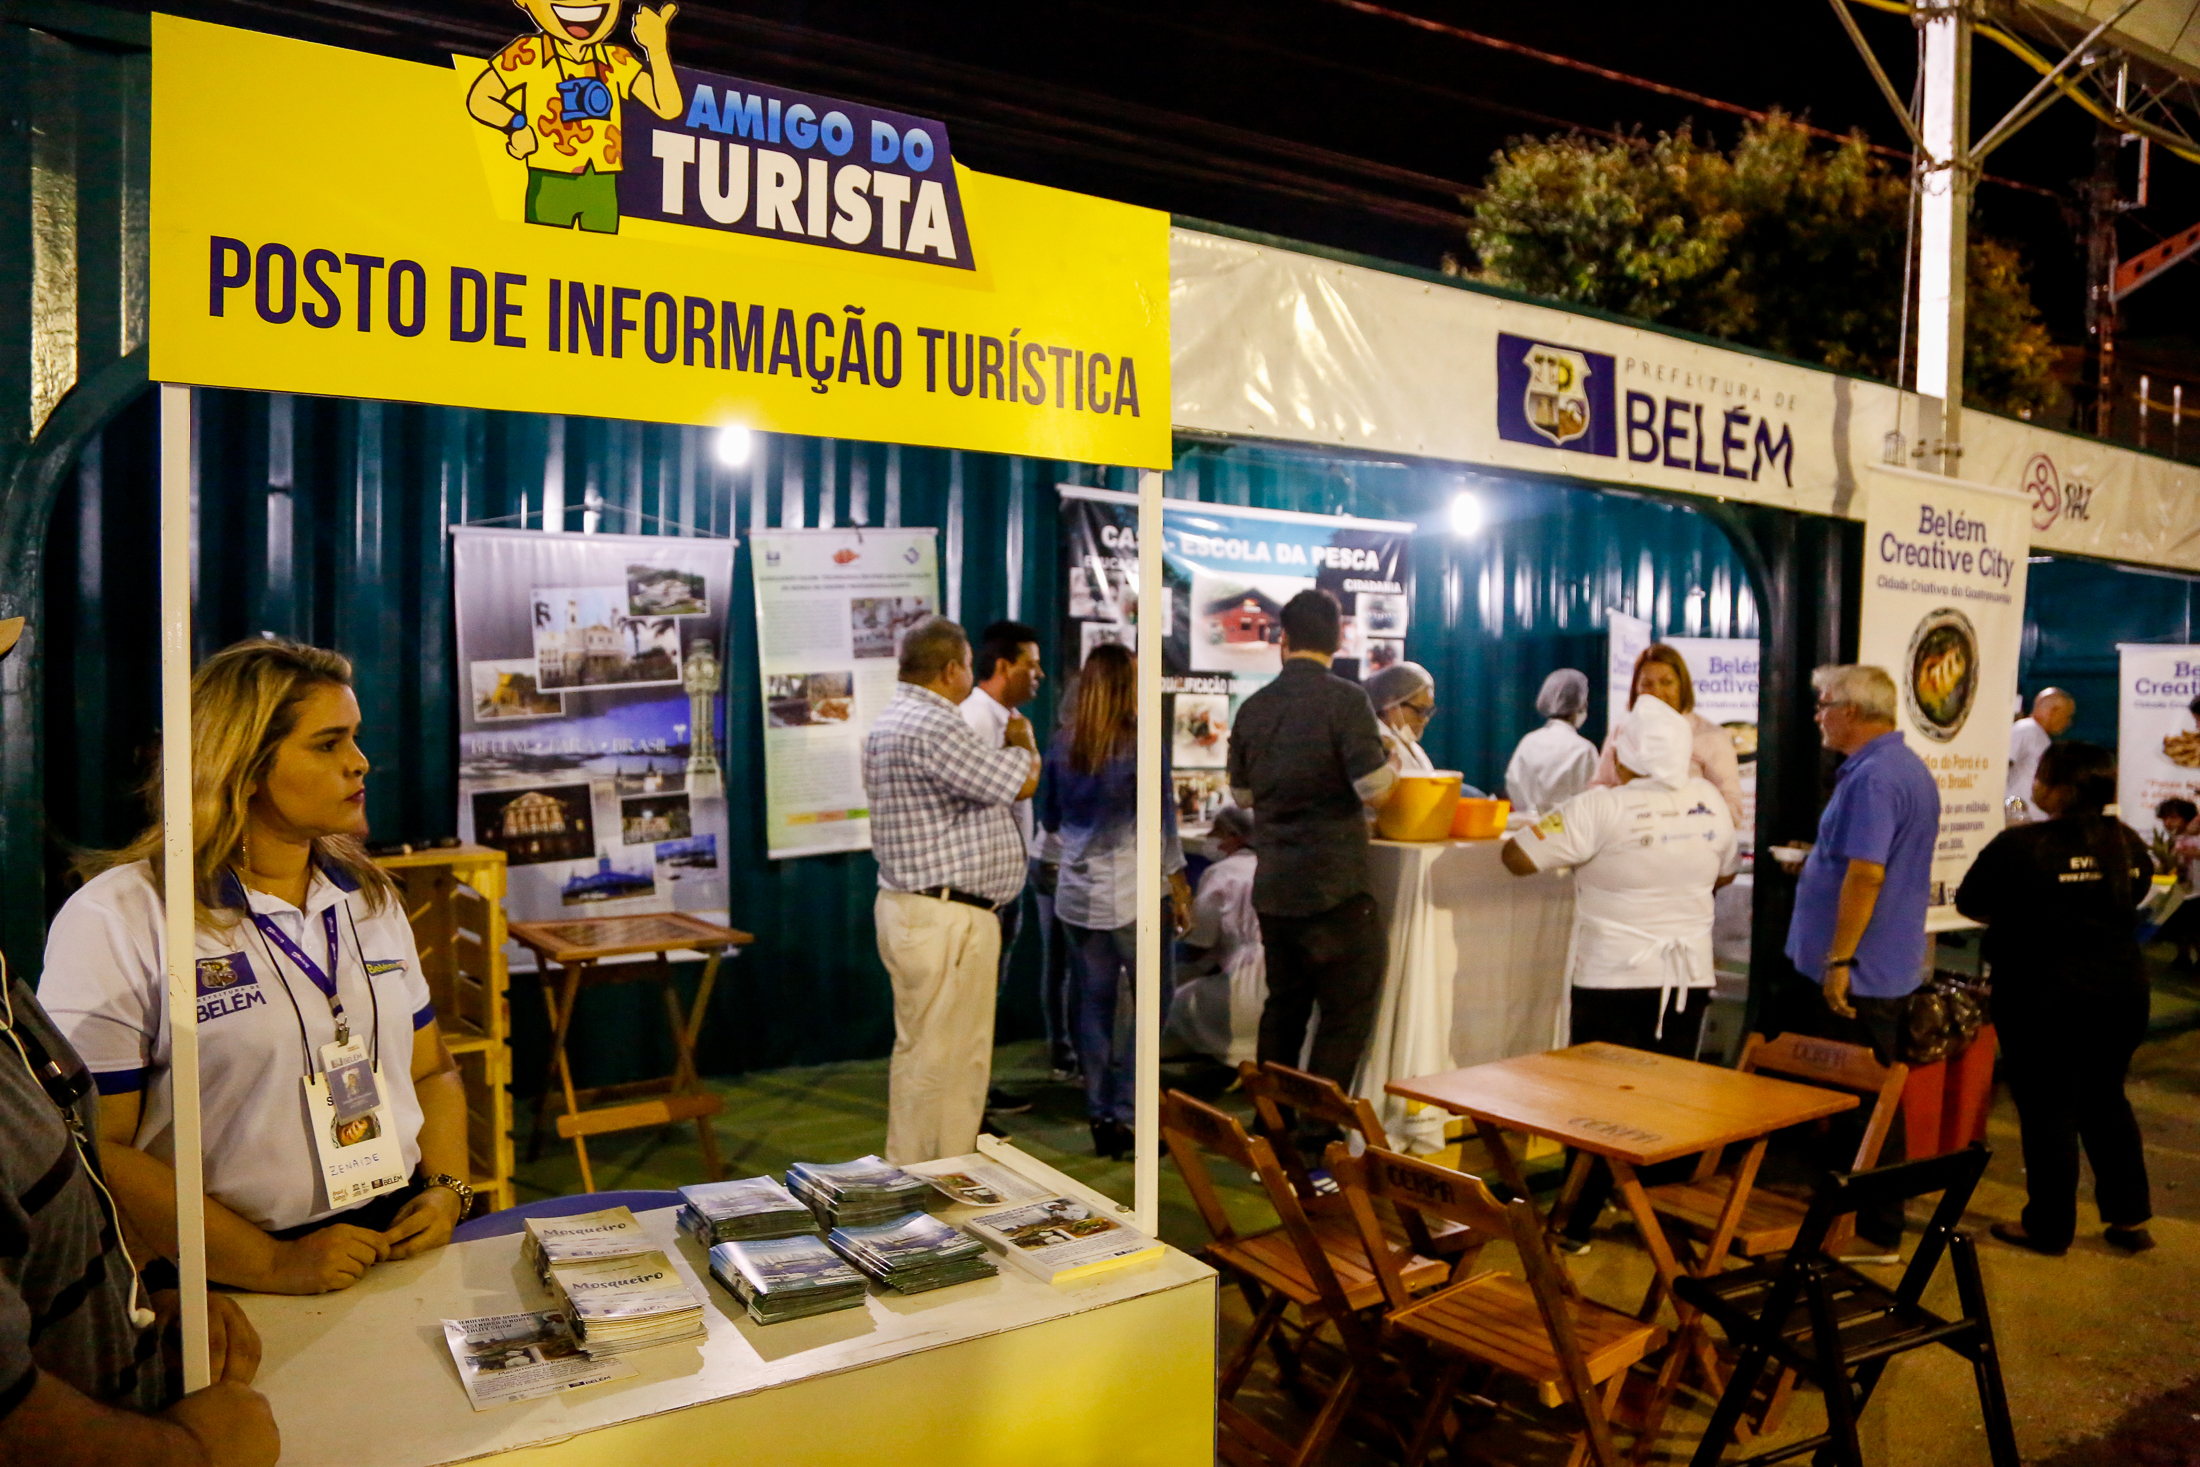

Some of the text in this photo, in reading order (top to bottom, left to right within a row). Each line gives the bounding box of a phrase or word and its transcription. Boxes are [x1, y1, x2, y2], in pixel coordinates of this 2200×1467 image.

[685, 83, 934, 172] AMIGO DO
[652, 128, 957, 260] TURISTA
[209, 235, 1141, 418] POSTO DE INFORMAÇÃO TURÍSTICA
[1625, 356, 1797, 410] PREFEITURA DE
[1626, 389, 1795, 488] BELÉM
[1918, 504, 1987, 544] Belém
[1181, 537, 1272, 563] ESCOLA
[1276, 541, 1308, 565] DA
[1312, 545, 1381, 572] PESCA
[1880, 531, 2015, 588] Creative City
[197, 987, 245, 1003] REFEITURA
[197, 990, 267, 1024] BELÉM
[329, 1152, 380, 1177] ZENAIDE
[383, 1174, 404, 1187] BELÉM
[543, 1221, 627, 1236] Mosqueiro
[572, 1271, 663, 1290] Mosqueiro
